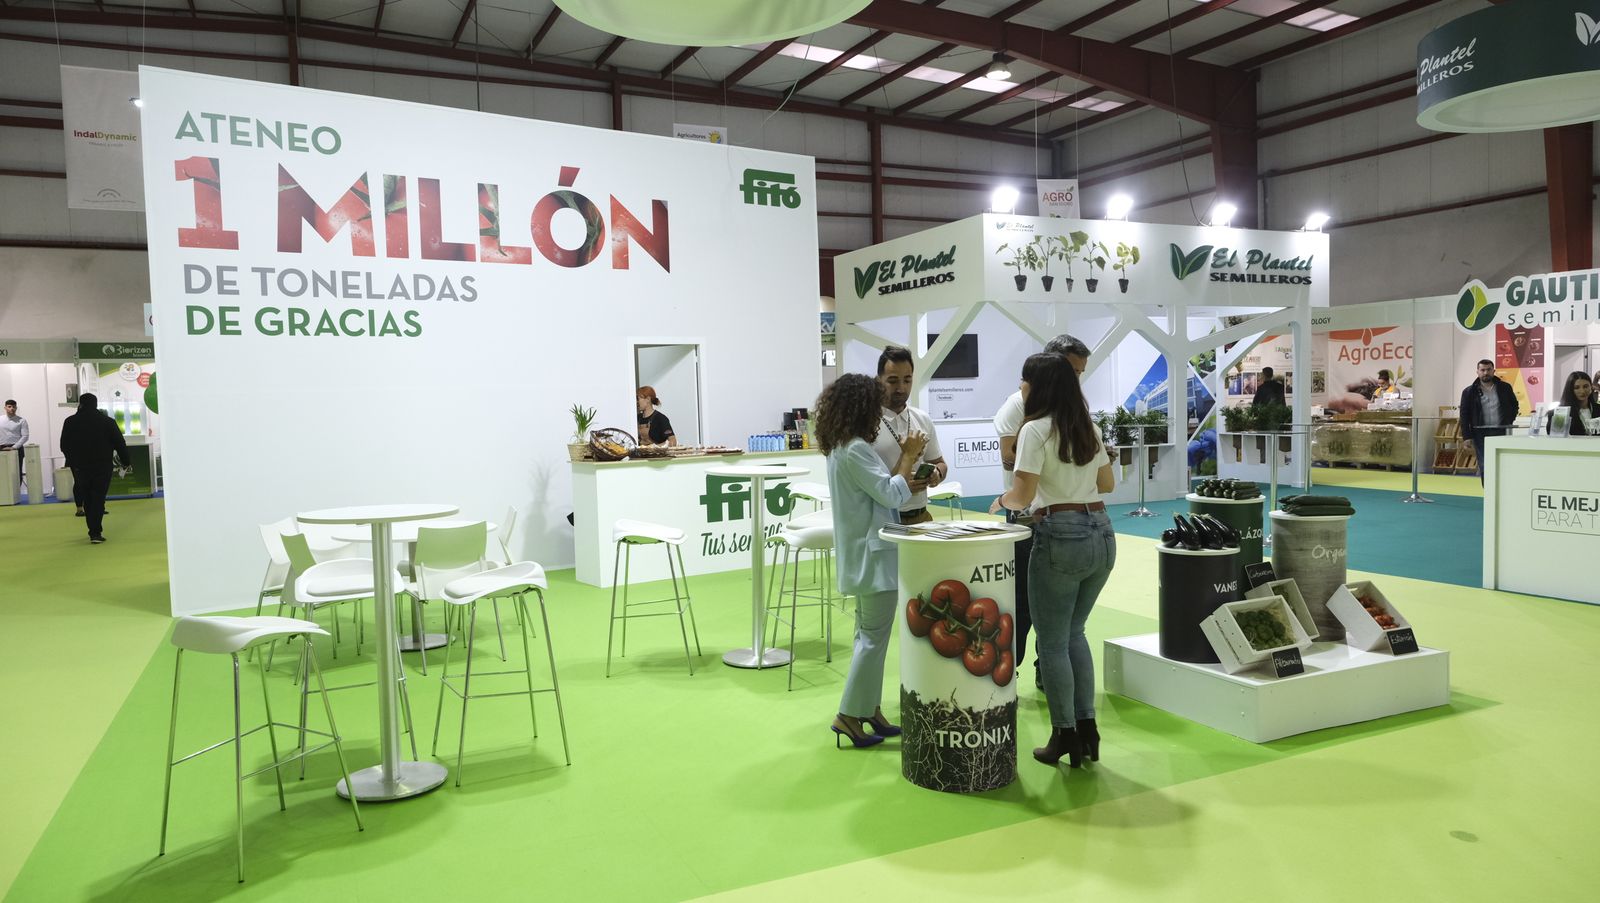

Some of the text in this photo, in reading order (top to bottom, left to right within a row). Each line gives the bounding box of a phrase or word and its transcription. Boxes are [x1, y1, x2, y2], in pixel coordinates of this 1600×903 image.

[1420, 37, 1477, 81] Plantel
[74, 130, 137, 141] IndalDynamic
[175, 110, 342, 155] ATENEO
[740, 168, 801, 209] fitó
[1042, 192, 1073, 202] AGRO
[174, 156, 670, 273] 1 MILLÓN
[879, 245, 956, 282] El Plantel
[1211, 248, 1314, 270] El Plantel
[184, 264, 478, 302] DE TONELADAS
[878, 271, 955, 295] SEMILLEROS
[1210, 272, 1312, 285] SEMILLEROS
[1506, 273, 1598, 306] GAUTI
[186, 305, 422, 337] DE GRACIAS
[958, 440, 999, 452] EL MEJO
[958, 452, 984, 464] PARA
[1537, 495, 1599, 512] EL MEJ
[1537, 511, 1599, 529] PARA T
[701, 532, 725, 557] Tus
[936, 723, 1011, 749] TRONIX
